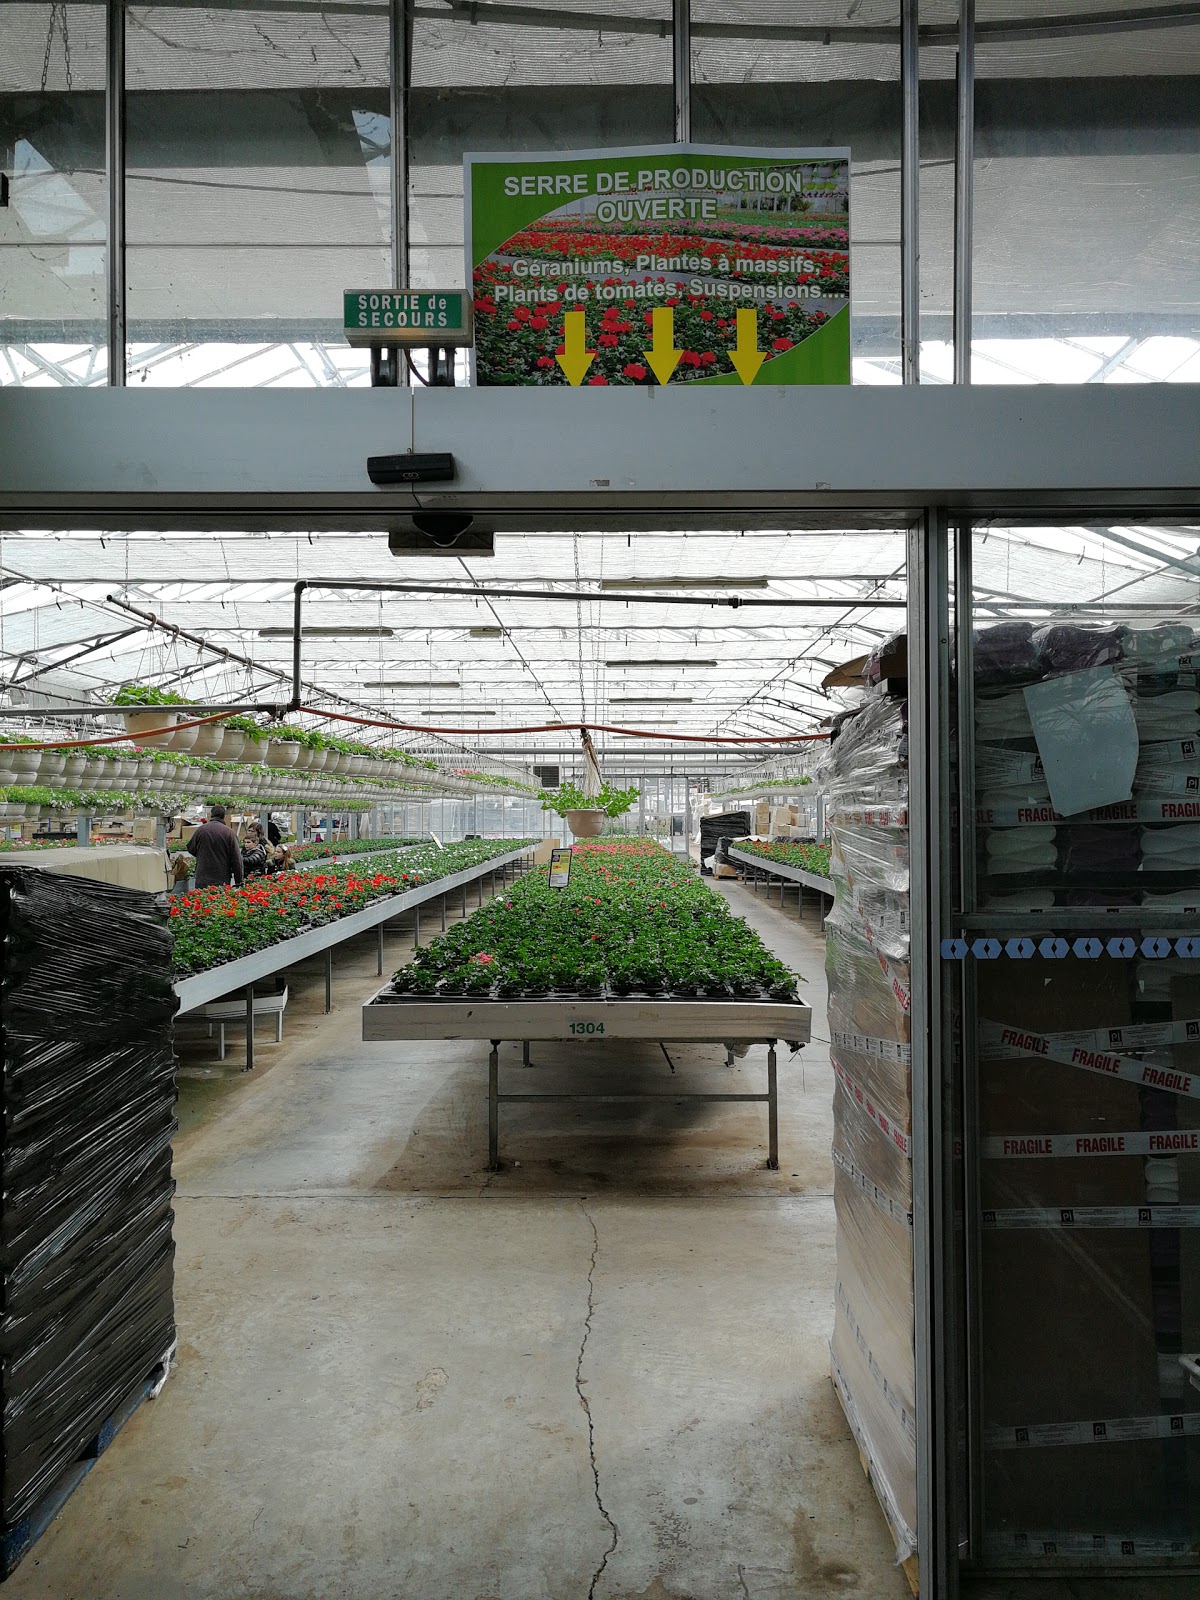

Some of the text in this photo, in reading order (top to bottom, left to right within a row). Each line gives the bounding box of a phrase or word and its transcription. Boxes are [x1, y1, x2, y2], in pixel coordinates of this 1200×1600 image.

[504, 168, 802, 196] SERRE DE PRODUCTION
[597, 198, 718, 223] OUVERTE
[512, 254, 821, 277] Géraniums, Plantes à massifs,
[494, 278, 846, 303] Plants de tomates, Suspensions....
[358, 294, 447, 310] SORTIE de
[358, 311, 448, 327] SECOURS
[1017, 807, 1063, 822] FRAGIL
[1161, 803, 1200, 818] FRAGIL
[569, 1022, 605, 1034] 1304
[1001, 1029, 1050, 1055] FRAGILE
[1072, 1048, 1121, 1074] FRAGILE
[1142, 1067, 1191, 1092] FRAGILE
[1003, 1134, 1198, 1154] FRAGILE FRAGILE FRAGILE
